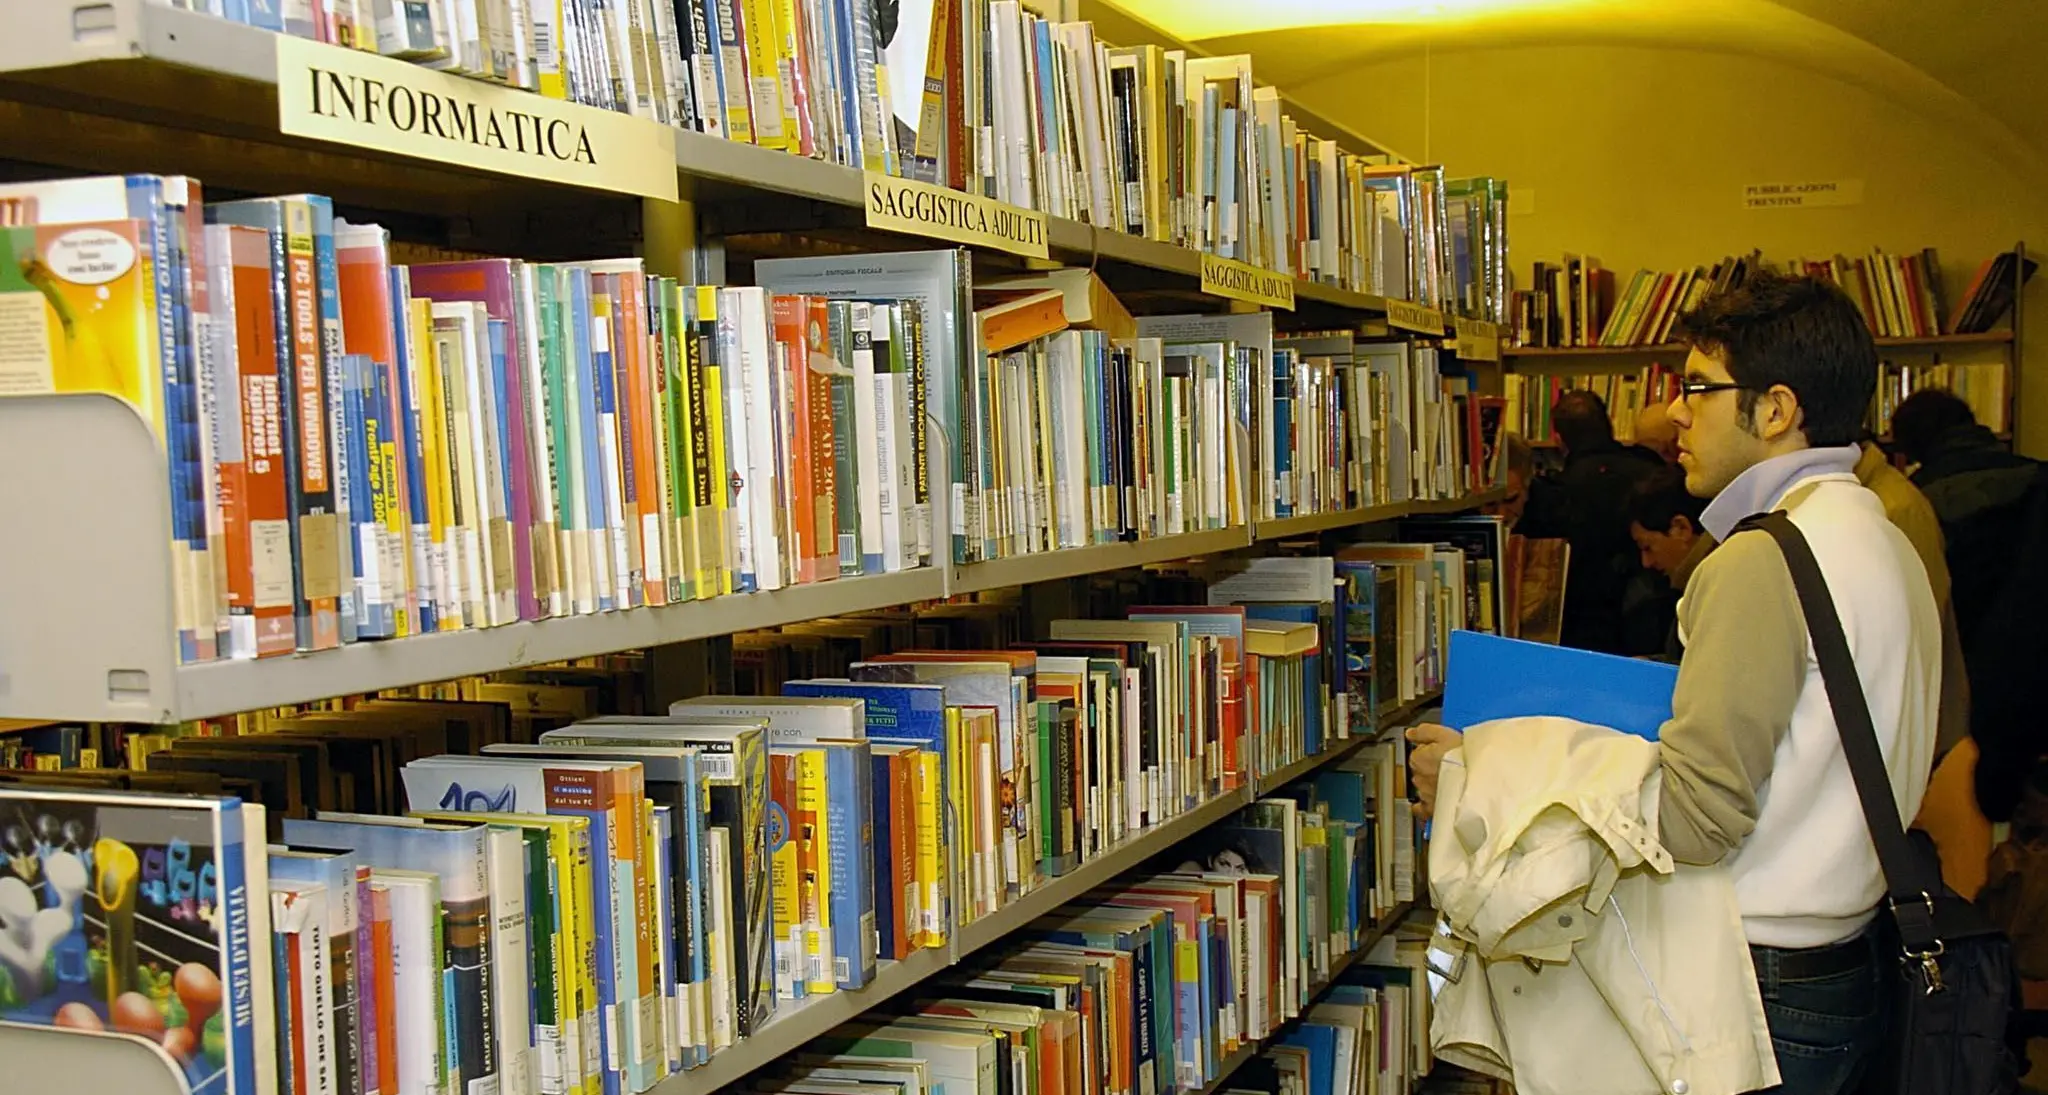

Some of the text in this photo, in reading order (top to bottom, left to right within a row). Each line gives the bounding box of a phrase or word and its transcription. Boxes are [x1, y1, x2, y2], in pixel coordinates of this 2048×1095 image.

[308, 67, 598, 165] INFORMATICA
[870, 182, 1043, 246] SAGGISTICA ADULTI
[294, 257, 311, 285] PC
[1203, 264, 1293, 302] SAGGISTICA ADULTI
[296, 287, 315, 346] TOOLS
[161, 292, 179, 386] INTERNET
[913, 322, 924, 381] COMPUTER
[300, 353, 317, 389] PER
[688, 337, 703, 426] Windows
[248, 374, 268, 457] Explorer
[261, 374, 283, 455] Internet
[916, 402, 926, 452] EUROPEA
[303, 390, 323, 481] WINDOWS
[334, 401, 347, 473] EUROPEA
[366, 418, 382, 490] FrontPage
[694, 431, 707, 455] 98
[254, 459, 271, 475] 5
[918, 453, 927, 493] PATENTE
[562, 786, 592, 795] massimo
[583, 798, 593, 806] PC
[480, 966, 490, 986] che
[1137, 966, 1147, 1002] CAPIRE
[312, 926, 330, 1091] TUTTO QUELLO CHE SAI
[347, 1005, 356, 1026] che
[481, 988, 492, 1018] porta
[347, 1028, 359, 1061] porta
[1140, 1018, 1149, 1057] FINANZA
